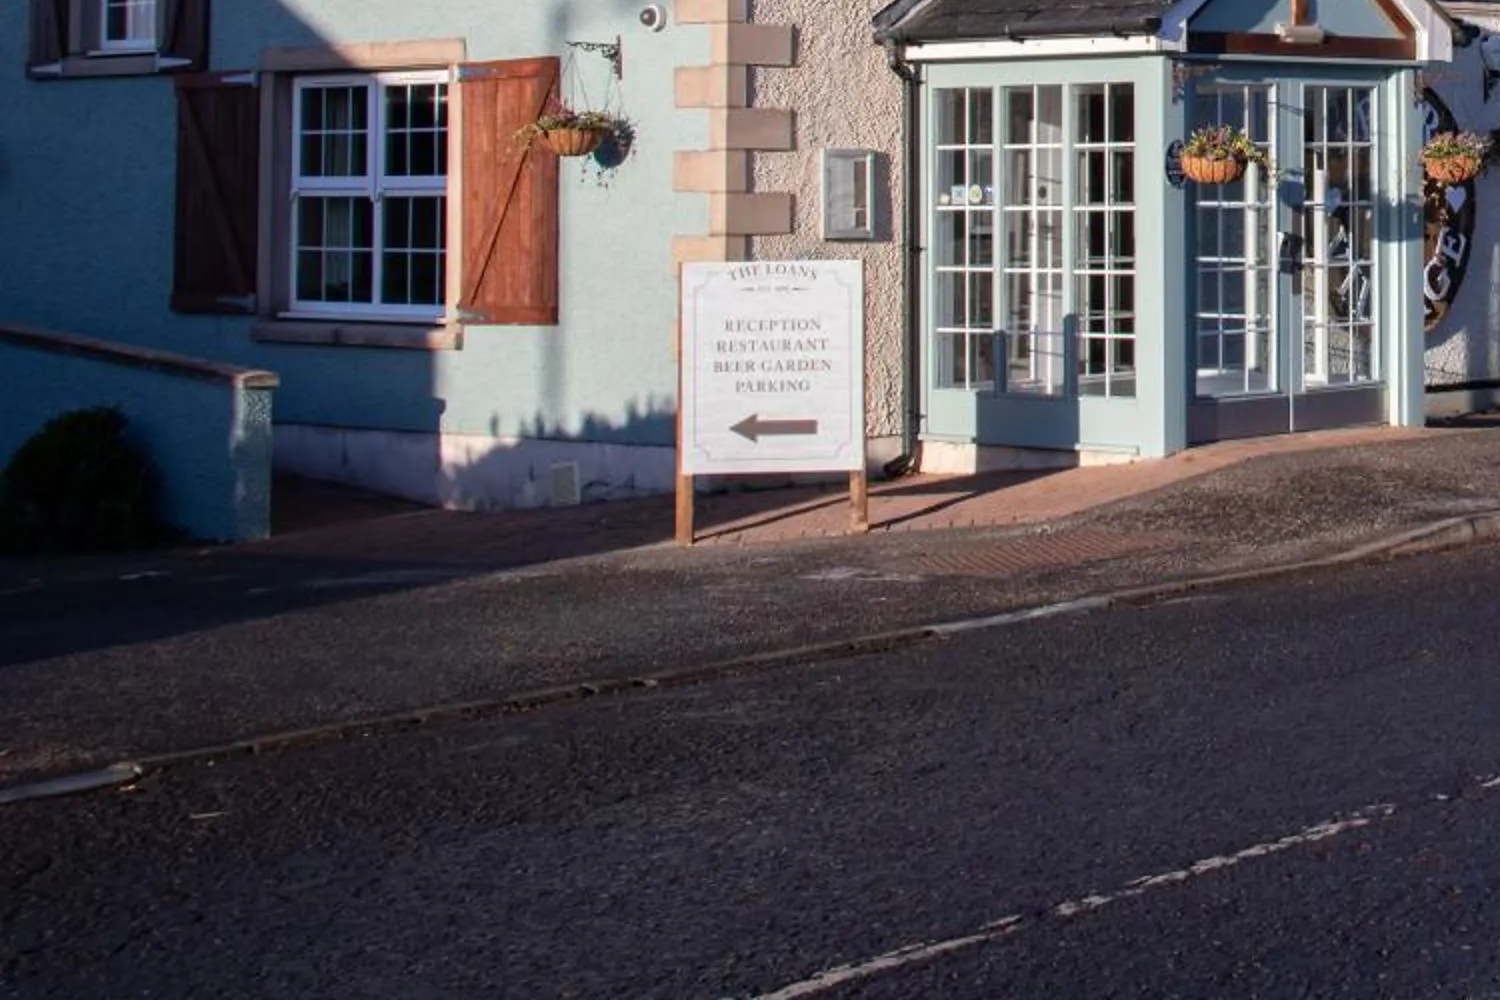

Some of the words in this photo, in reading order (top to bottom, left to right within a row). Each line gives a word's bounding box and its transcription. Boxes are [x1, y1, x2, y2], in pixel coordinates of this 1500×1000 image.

[727, 264, 759, 281] THE
[765, 263, 817, 280] LOANS
[724, 318, 822, 333] RECEPTION
[716, 338, 830, 353] RESTAURANT
[713, 359, 756, 374] BEER
[760, 358, 833, 373] GARDEN
[735, 379, 811, 394] PARKING
